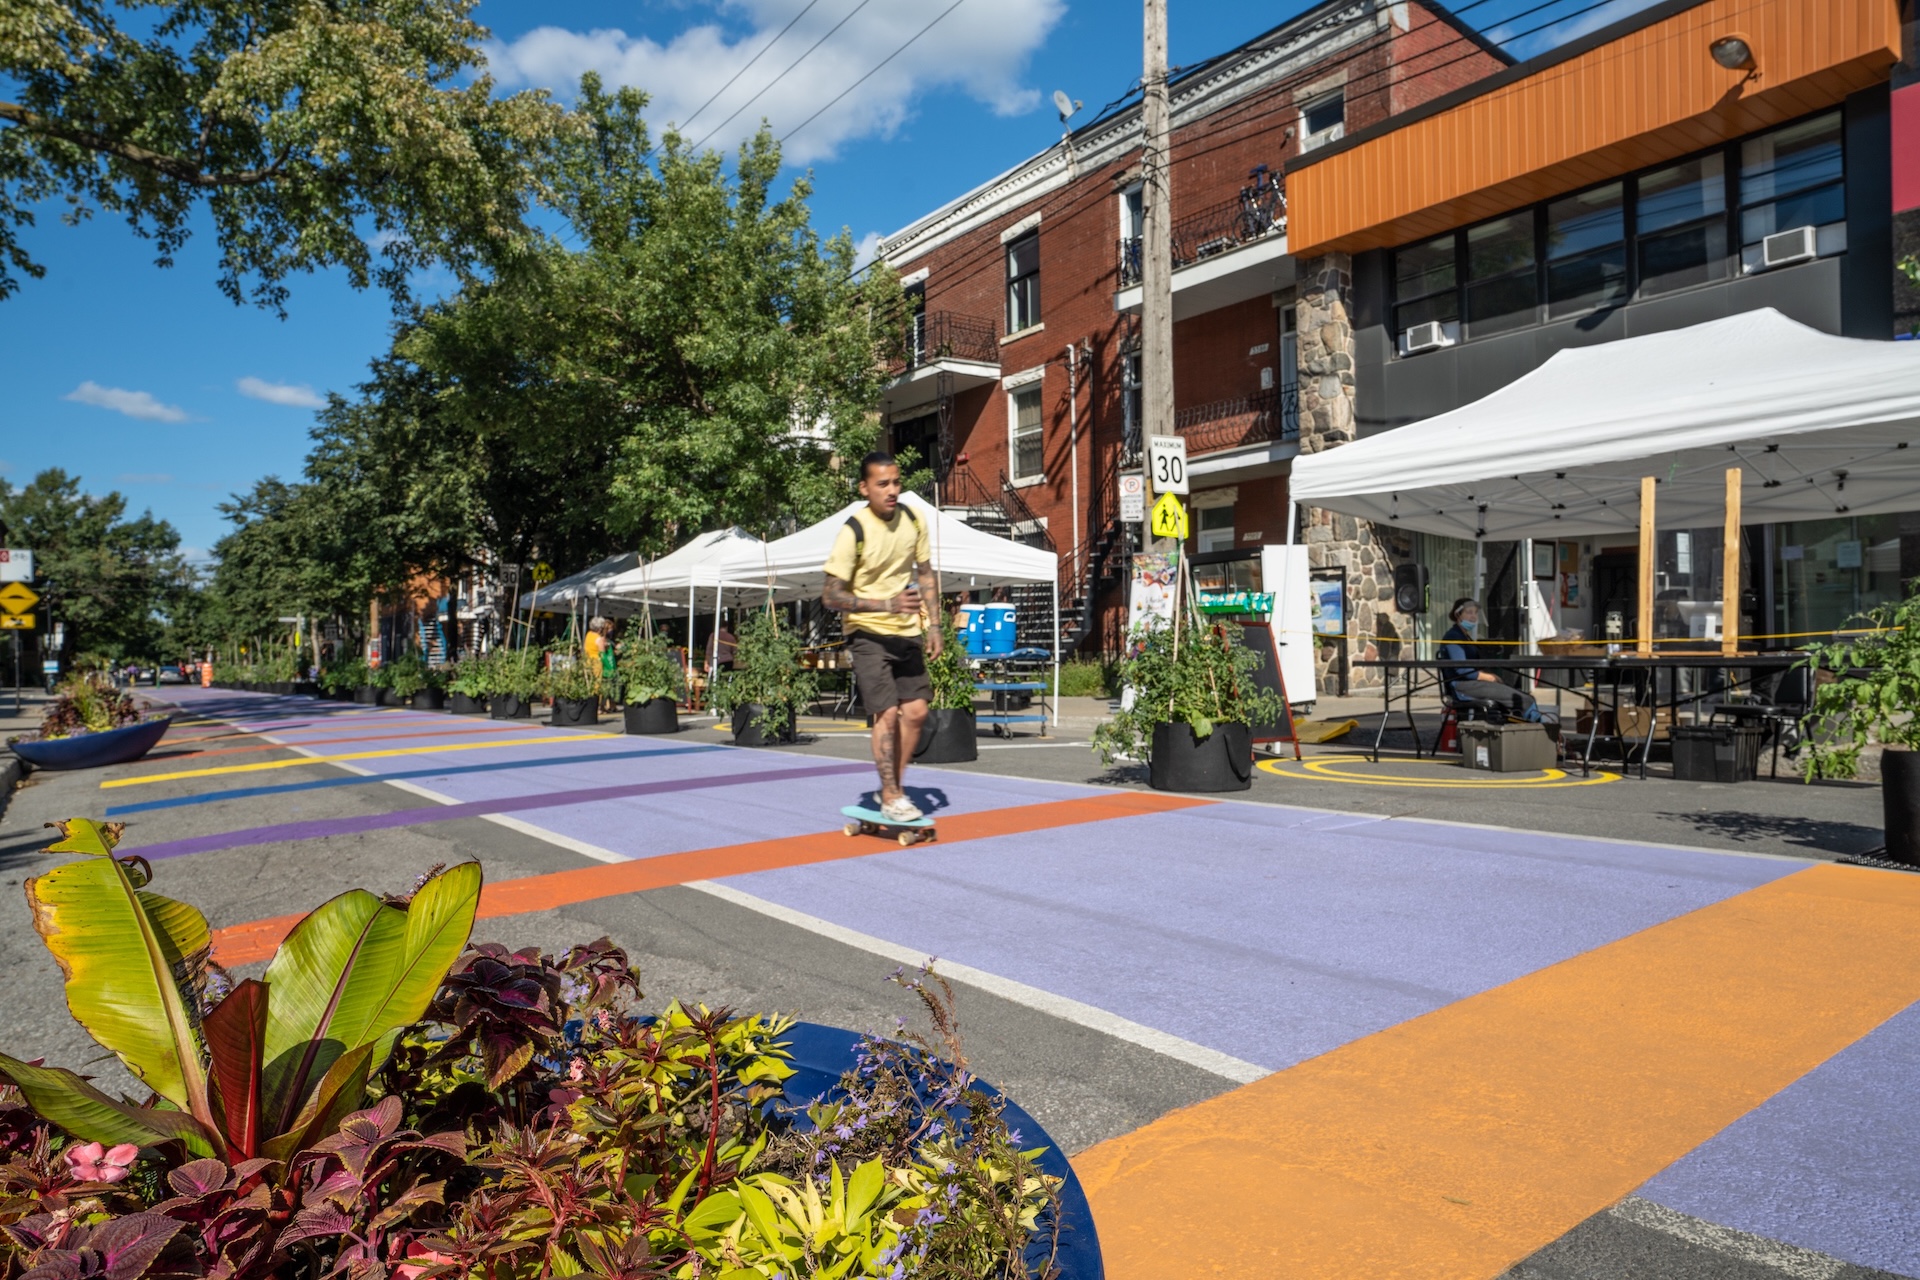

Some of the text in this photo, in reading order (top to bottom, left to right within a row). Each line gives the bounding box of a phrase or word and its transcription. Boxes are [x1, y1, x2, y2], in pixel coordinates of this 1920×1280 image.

[1154, 441, 1182, 449] MAXIMUM
[1157, 455, 1183, 484] 30
[502, 571, 517, 584] 30
